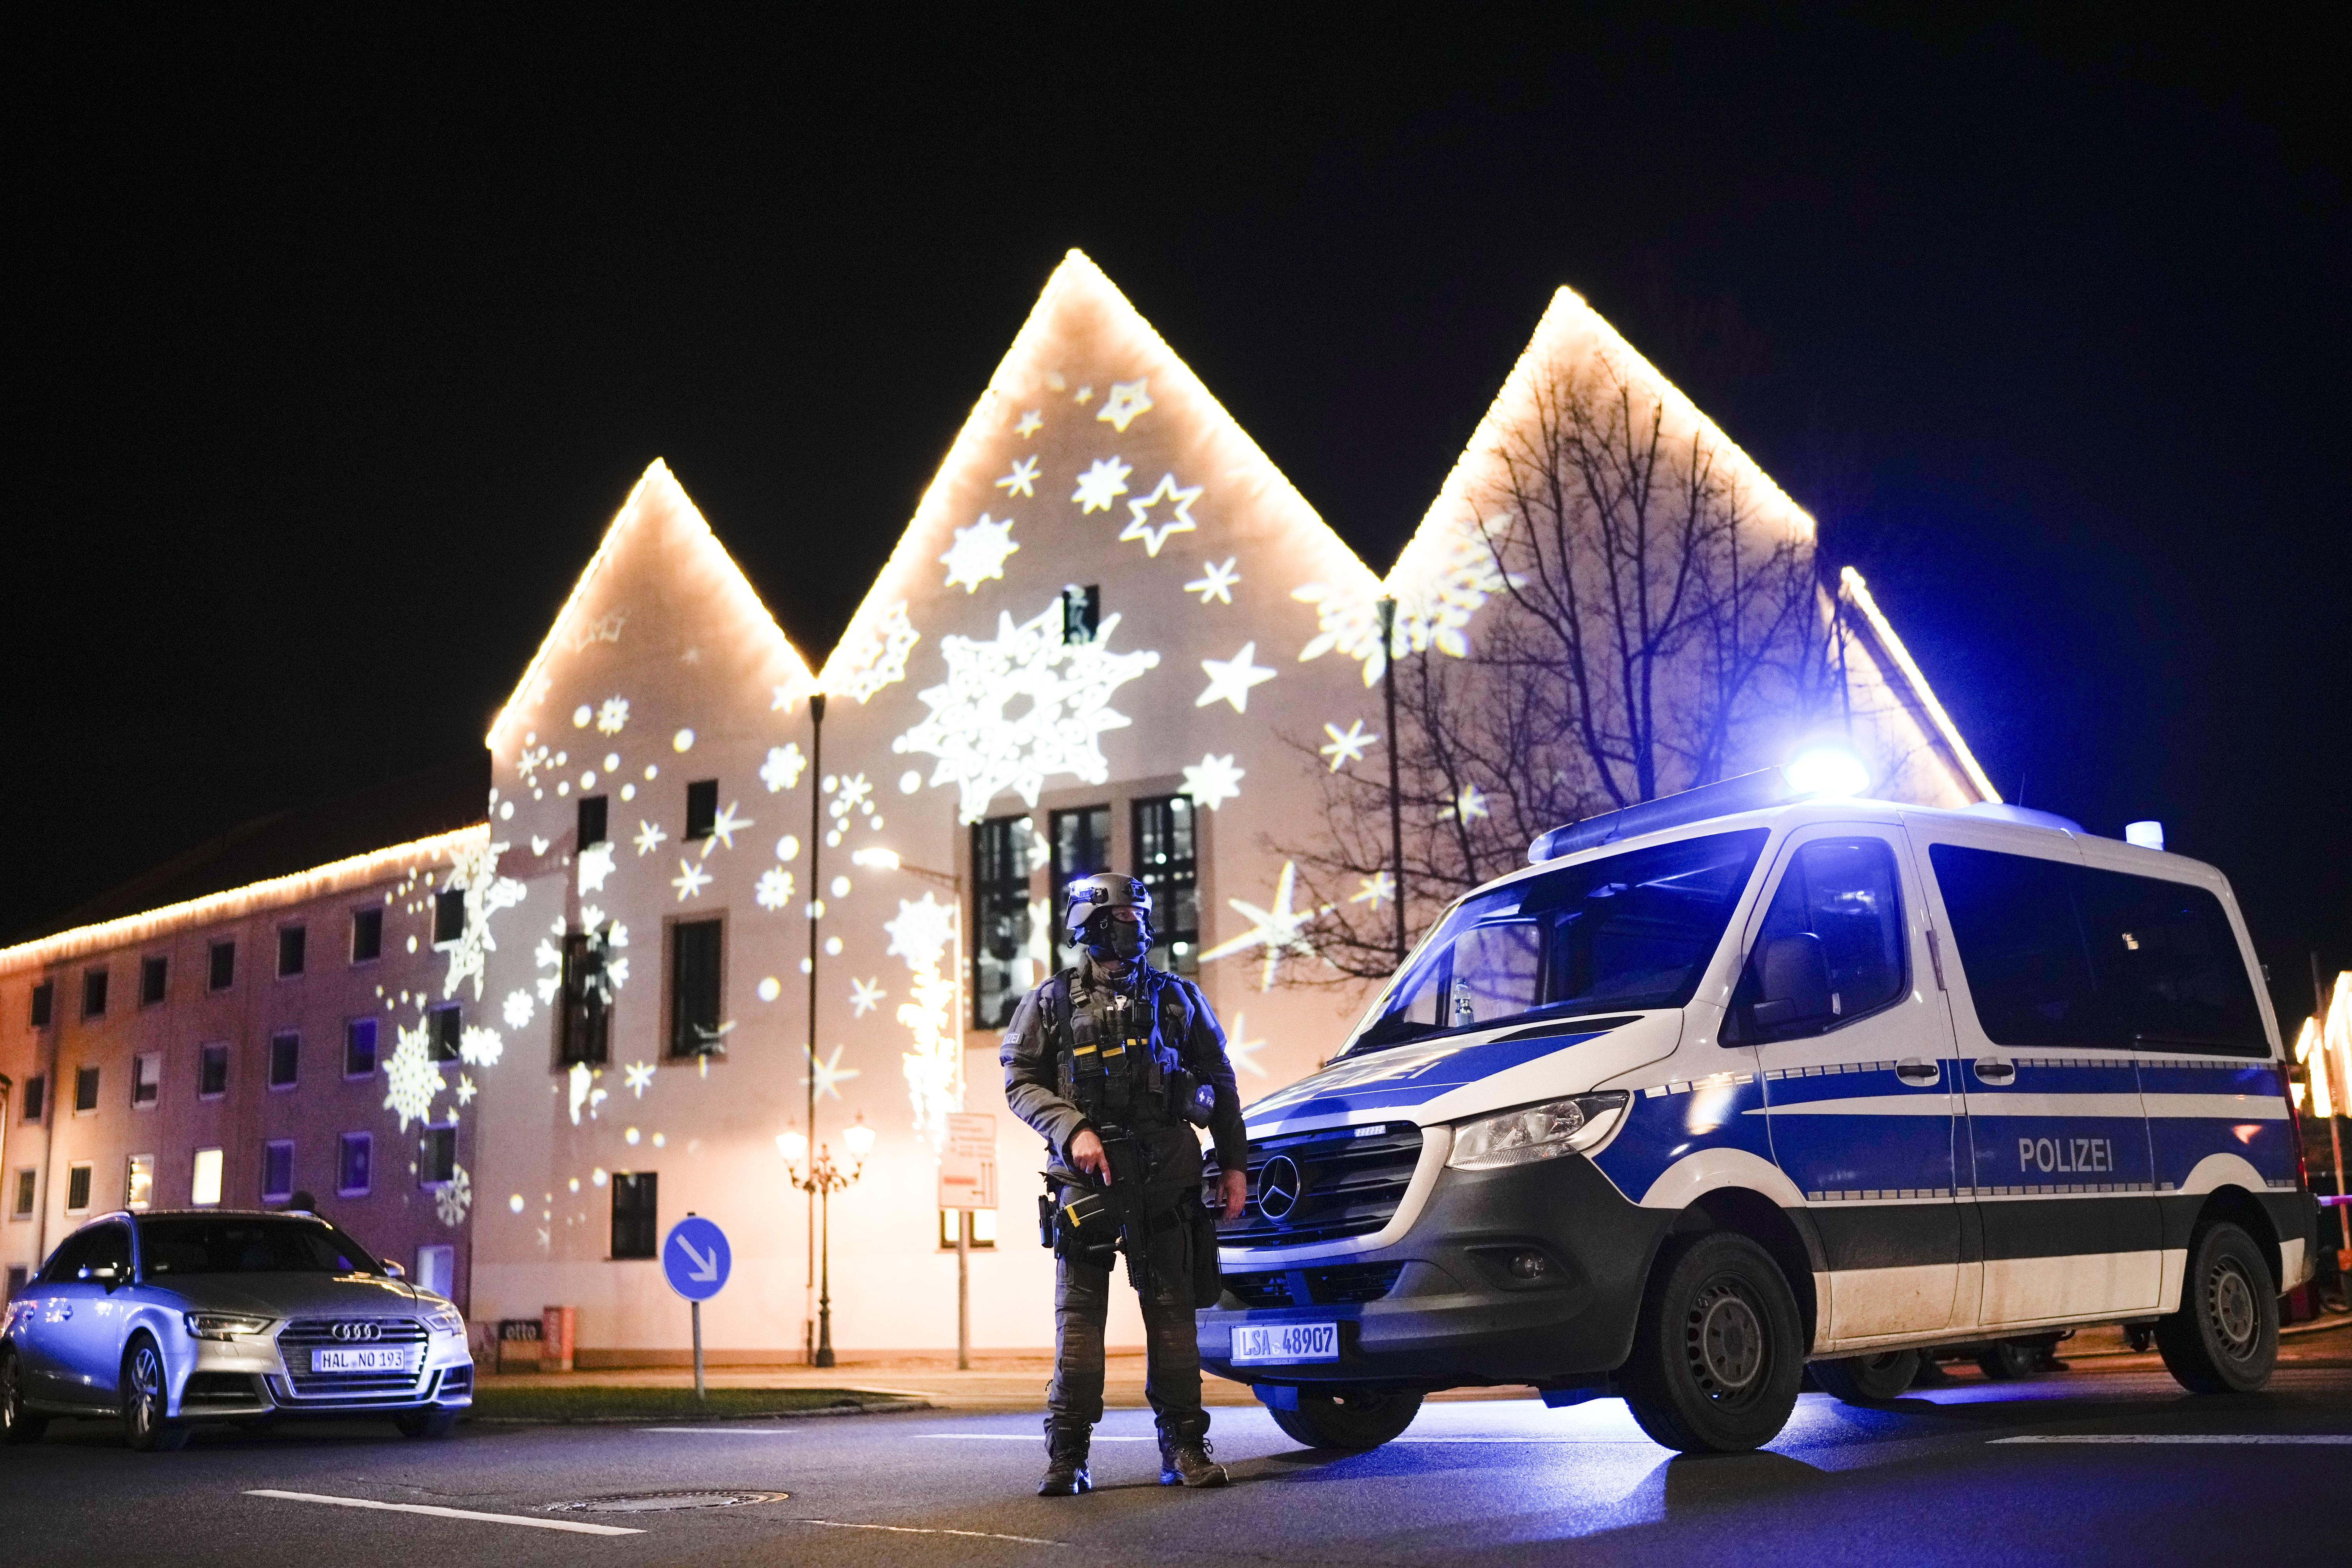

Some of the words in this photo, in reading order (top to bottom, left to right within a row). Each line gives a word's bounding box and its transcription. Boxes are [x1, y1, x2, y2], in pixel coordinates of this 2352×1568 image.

[2019, 1138, 2112, 1172] POLIZEI
[1242, 1329, 1270, 1356] LSA
[1282, 1327, 1333, 1354] 48907
[323, 1353, 348, 1368] HAL
[359, 1352, 375, 1367] NO
[379, 1352, 402, 1366] 193
